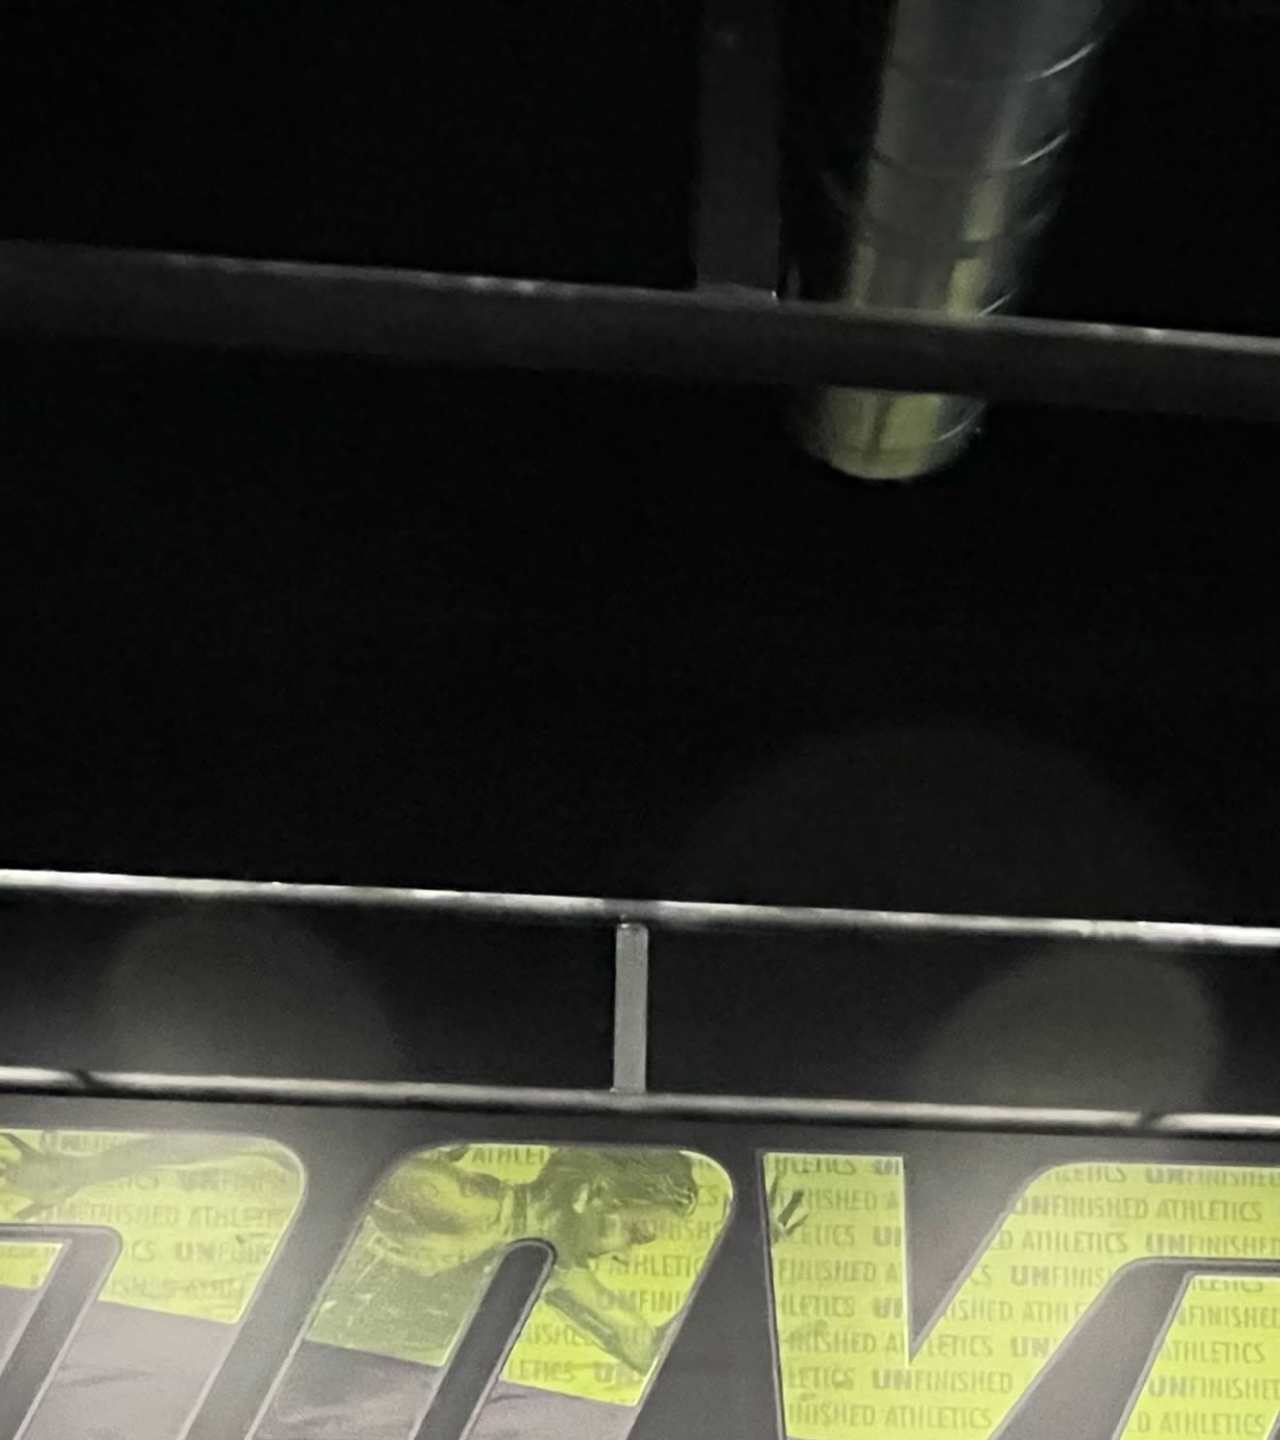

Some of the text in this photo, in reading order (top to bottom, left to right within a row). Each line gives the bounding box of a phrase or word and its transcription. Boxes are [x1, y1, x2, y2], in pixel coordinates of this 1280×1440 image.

[1155, 1198, 1263, 1223] ATHLETICS
[1022, 1229, 1129, 1254] ATHLETICS
[1161, 1340, 1266, 1365] ATHLETICS
[871, 1368, 1014, 1394] UNFINISHED
[884, 1404, 993, 1430] ATHLETICS
[1159, 1411, 1266, 1436] ATHLETICS
